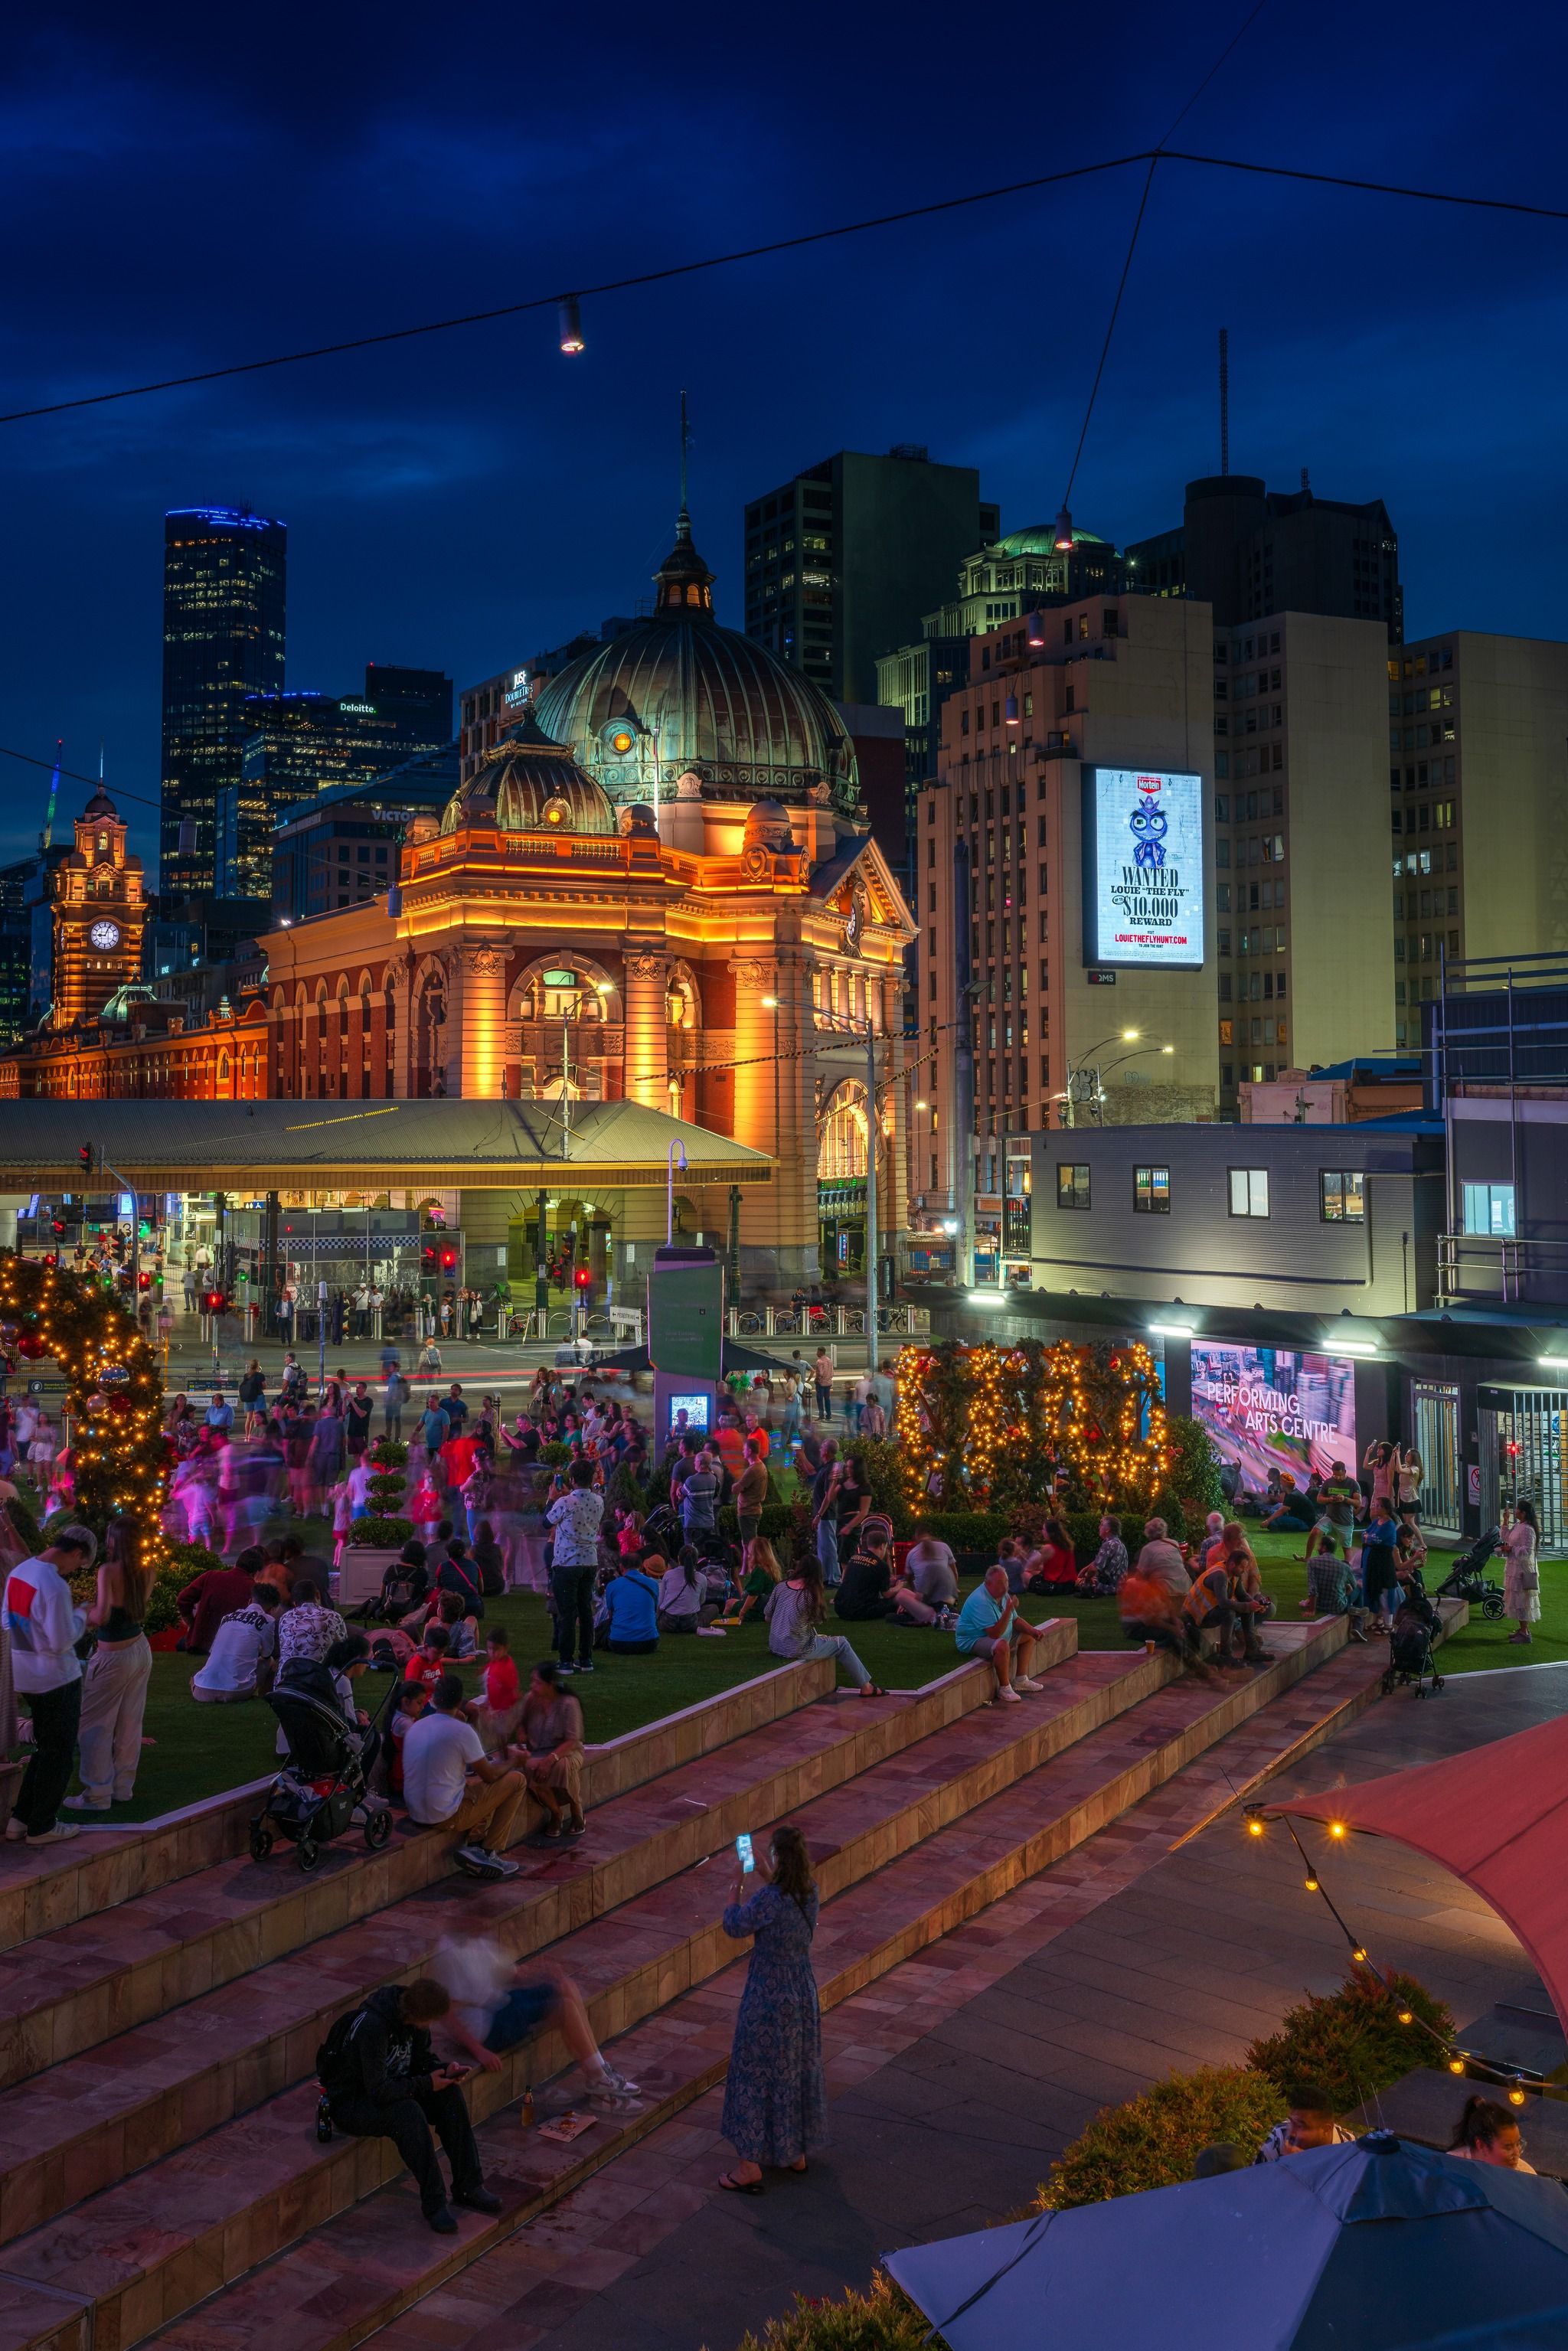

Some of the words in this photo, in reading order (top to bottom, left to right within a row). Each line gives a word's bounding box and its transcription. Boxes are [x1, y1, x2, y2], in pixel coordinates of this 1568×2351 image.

[1138, 779, 1160, 790] Mortein
[1122, 867, 1178, 888] WANTED
[1111, 885, 1141, 894] LOUIE
[1123, 895, 1178, 918] $10,000
[1129, 917, 1173, 926] REWARD
[1115, 934, 1187, 945] LOUIETHEFLYHUNT.COM
[1207, 1382, 1300, 1415] PERFORMING
[1245, 1410, 1278, 1434] ARTS
[1282, 1415, 1338, 1445] CENTRE
